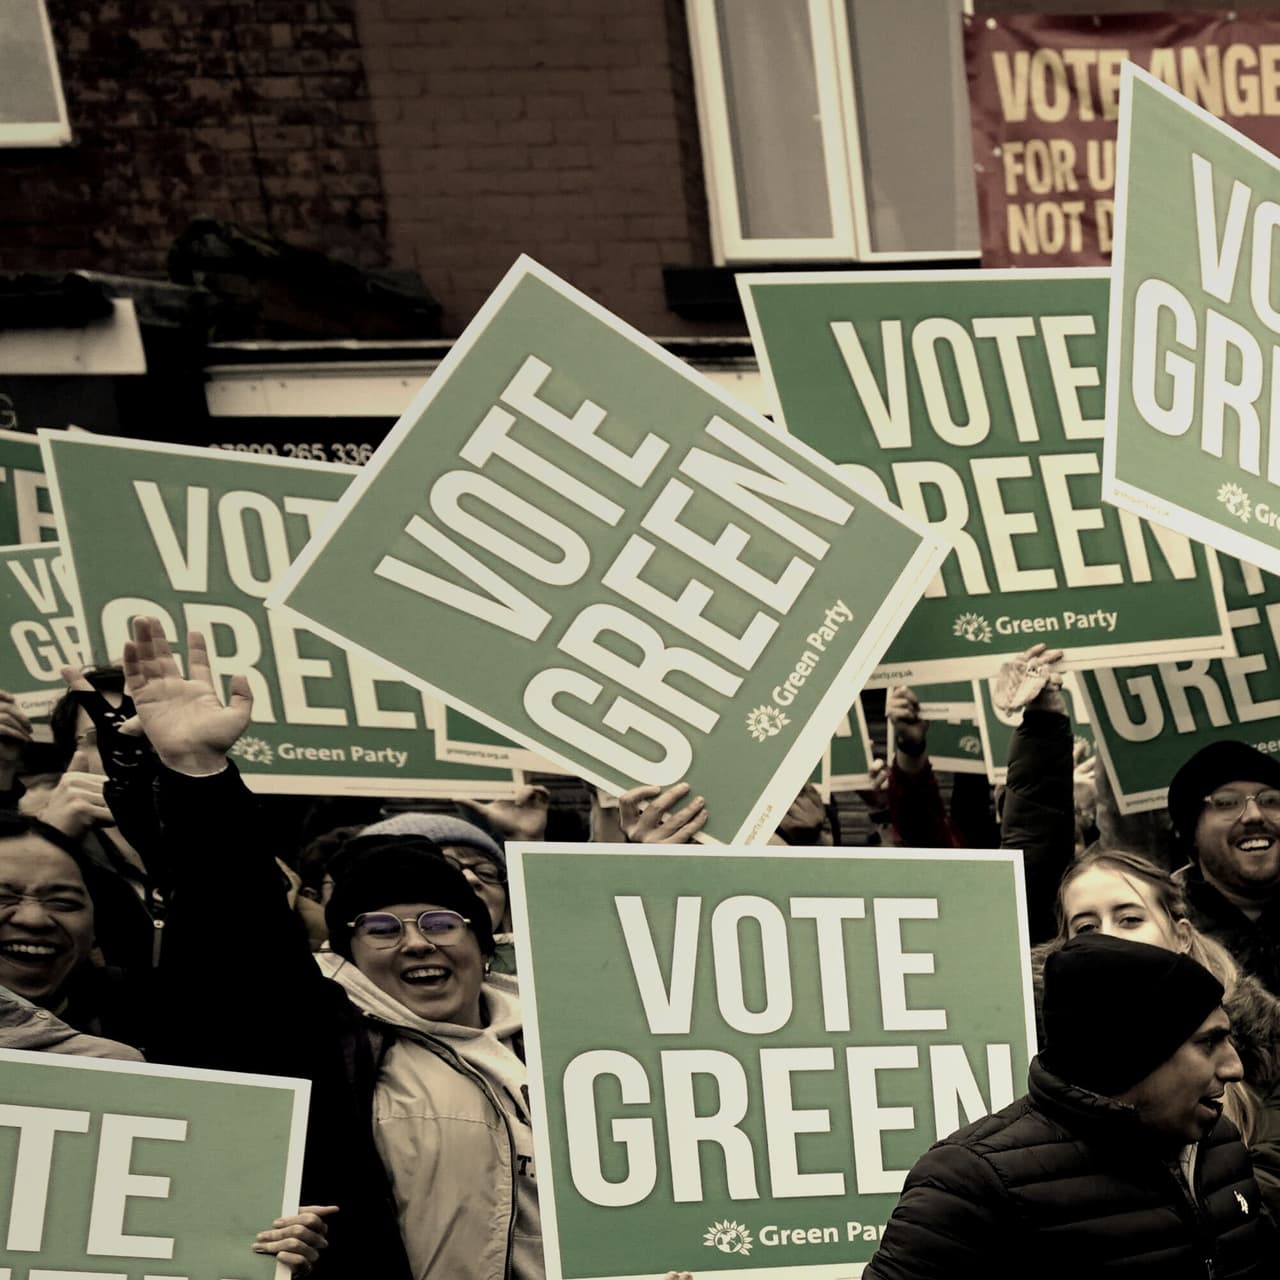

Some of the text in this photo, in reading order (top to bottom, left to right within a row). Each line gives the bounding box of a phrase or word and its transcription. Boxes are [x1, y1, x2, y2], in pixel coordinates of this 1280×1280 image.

[993, 49, 1128, 123] VOTE
[1002, 139, 1076, 195] FOR
[1007, 201, 1085, 255] NOT
[830, 315, 1105, 449] VOTE
[373, 355, 668, 642] VOTE
[835, 452, 1197, 598] REE
[523, 415, 855, 786] GREEN
[995, 608, 1118, 635] Green Party
[772, 599, 854, 707] Green Party
[278, 742, 408, 768] Green Party
[613, 894, 948, 1036] VOTE
[759, 1221, 887, 1247] Green Par
